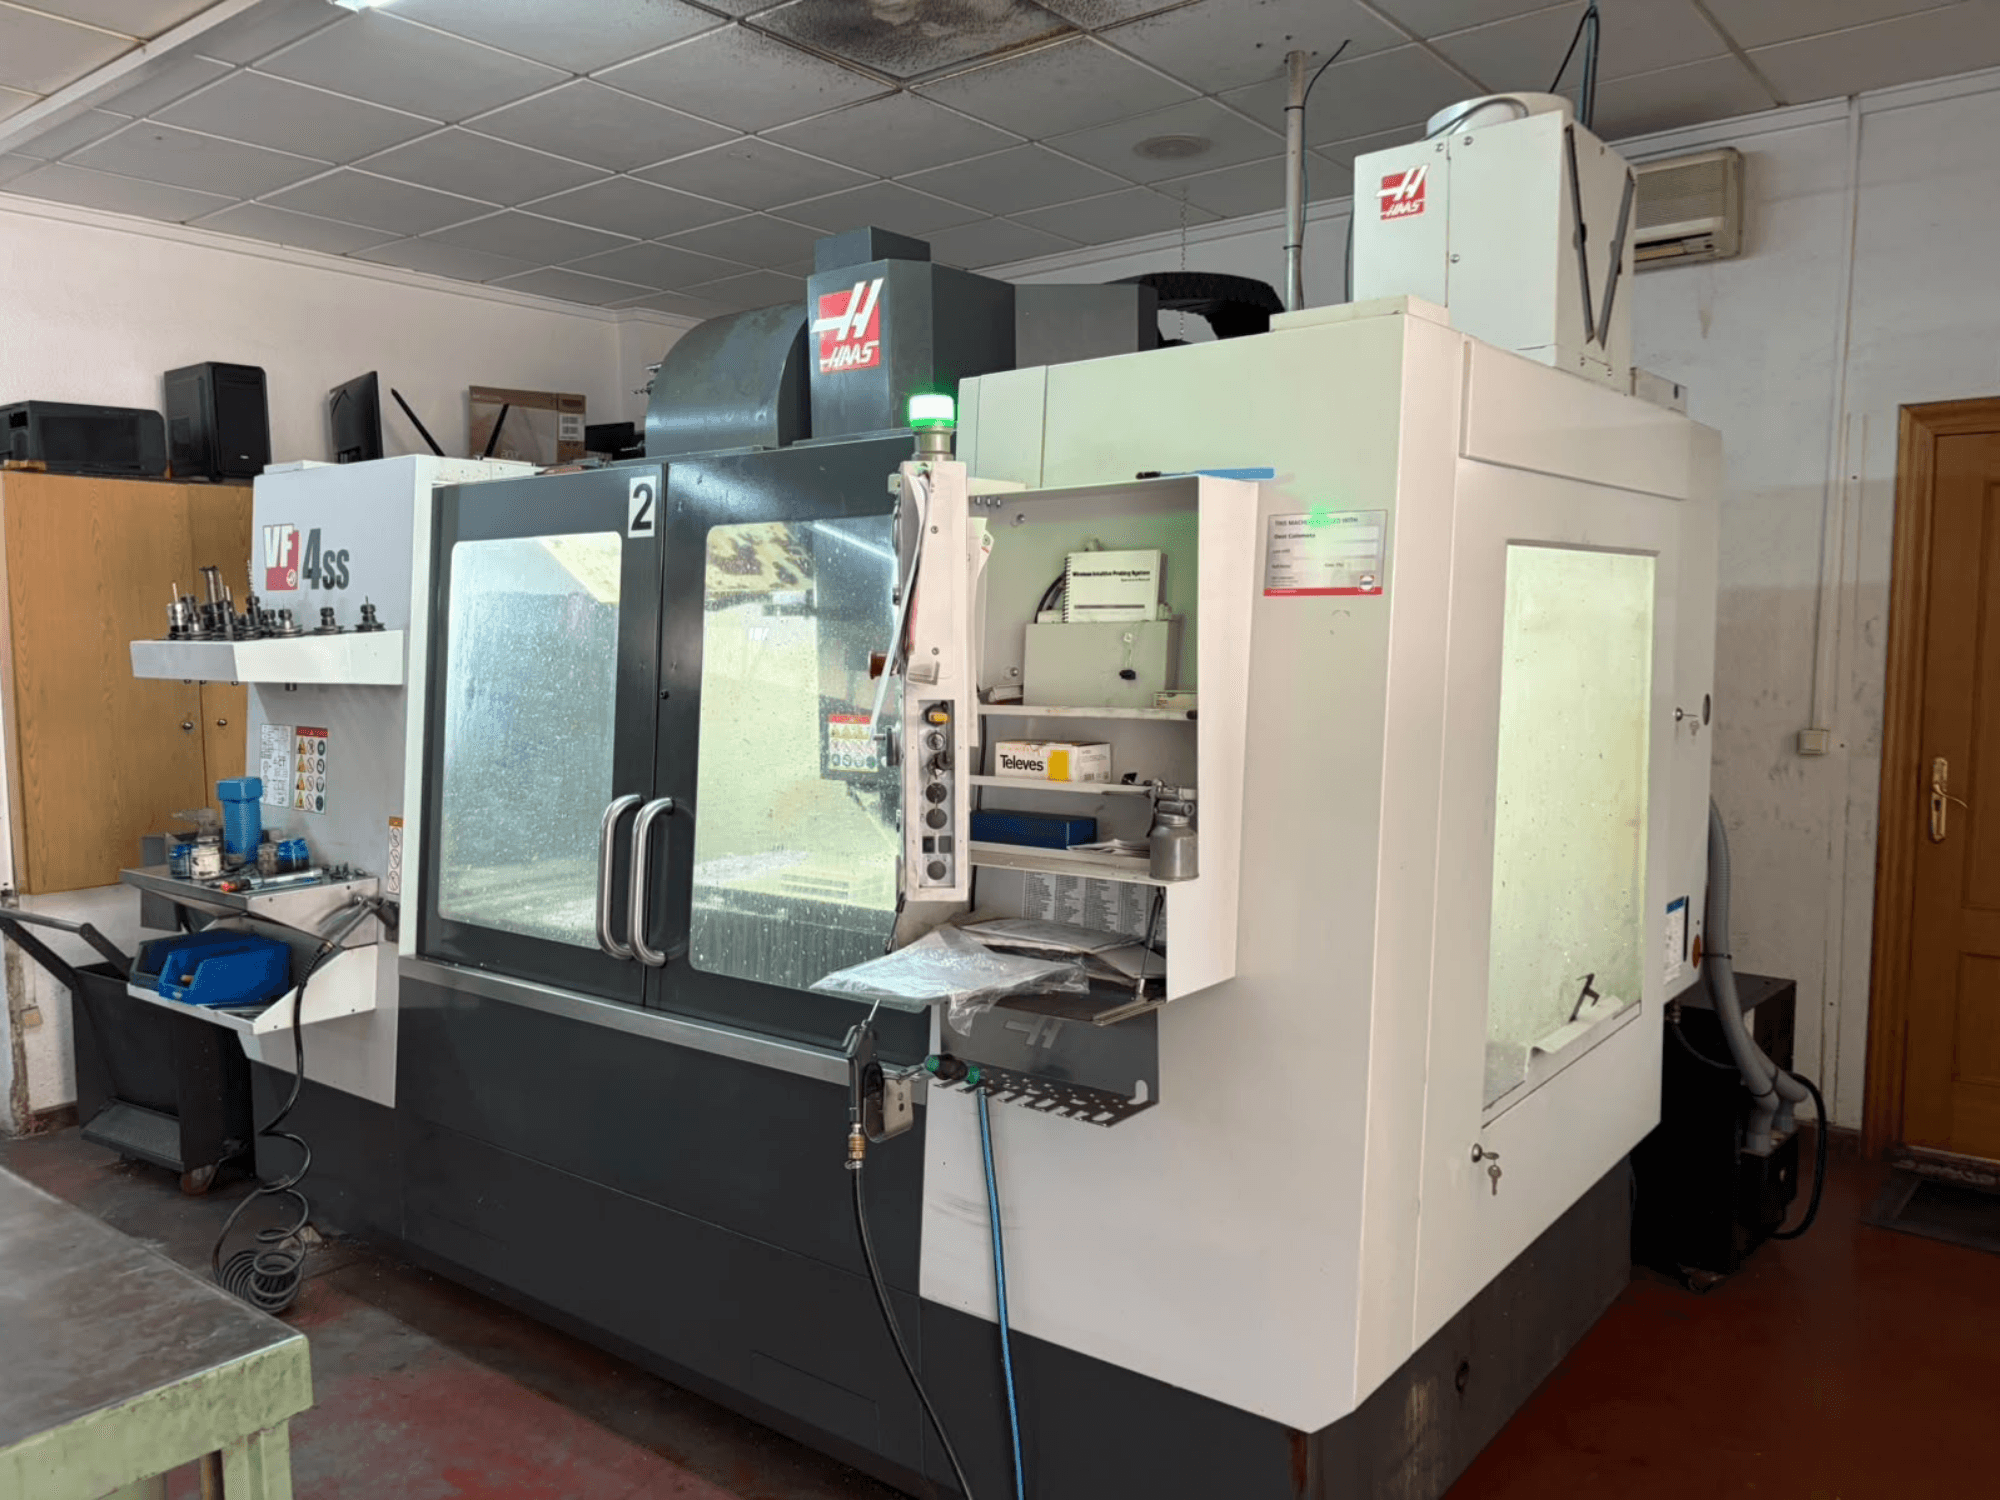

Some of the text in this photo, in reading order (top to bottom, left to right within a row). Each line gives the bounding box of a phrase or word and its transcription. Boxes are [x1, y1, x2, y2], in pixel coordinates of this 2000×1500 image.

[1380, 199, 1425, 217] HAAS
[820, 340, 880, 371] HAAS
[630, 483, 653, 531] 2
[263, 523, 294, 569] VF
